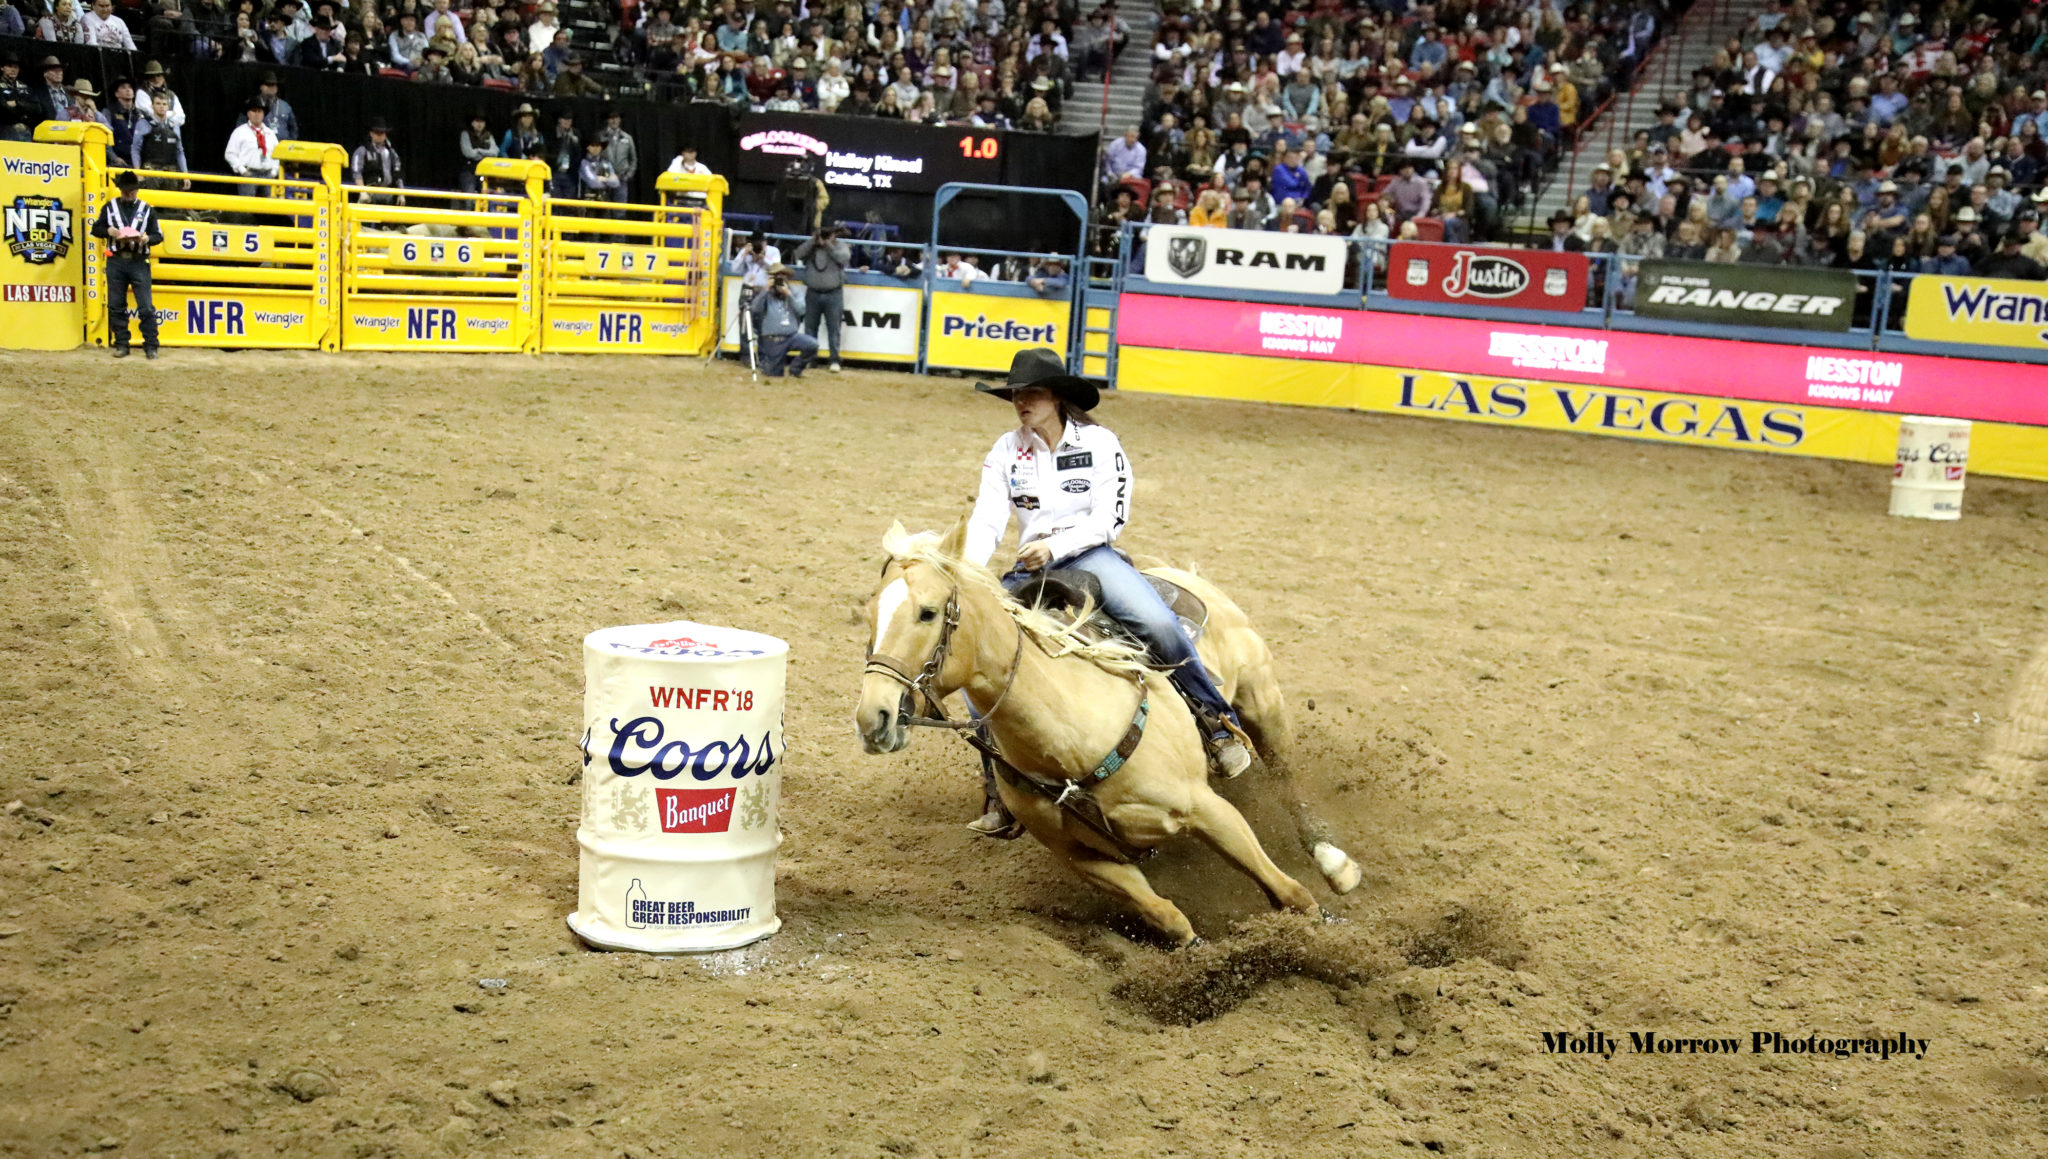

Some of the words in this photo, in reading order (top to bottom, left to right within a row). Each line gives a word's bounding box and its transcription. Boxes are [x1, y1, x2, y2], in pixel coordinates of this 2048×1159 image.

[959, 136, 998, 159] 1.0
[3, 157, 71, 183] Wrangler
[873, 174, 892, 188] TX
[5, 207, 71, 239] NFR
[30, 228, 48, 241] 60
[181, 230, 197, 250] 5
[244, 233, 260, 253] 5
[403, 242, 417, 261] 6
[457, 245, 471, 263] 6
[598, 252, 610, 269] 7
[646, 254, 657, 271] 7
[1215, 248, 1326, 272] RAM
[1442, 251, 1520, 297] Justin
[7, 285, 30, 301] LAS
[33, 286, 72, 302] VEGAS
[1648, 285, 1843, 316] RANGER
[187, 300, 244, 334] NFR
[254, 311, 305, 329] Wrangler
[354, 316, 400, 332] Wrangler
[407, 308, 457, 340] NFR
[466, 318, 511, 334] Wrangler
[553, 320, 593, 336] Wrangler
[599, 313, 642, 343] NFR
[841, 309, 902, 329] AM
[1259, 311, 1343, 339] HESSTON
[651, 323, 689, 337] Wrangler
[943, 314, 1055, 344] Priefert
[1309, 340, 1336, 354] HAY
[1805, 356, 1903, 387] HESSTON
[1807, 383, 1861, 401] KNOWS
[1861, 387, 1894, 404] HAY
[1398, 373, 1528, 420] LAS
[1554, 388, 1805, 448] VEGAS
[1060, 453, 1091, 467] YETI
[608, 716, 775, 781] Coors
[665, 793, 731, 828] Banquet
[632, 899, 666, 914] GREAT
[668, 901, 695, 914] BEER
[632, 911, 666, 925] GREAT
[668, 907, 751, 925] RESPONSIBILITY
